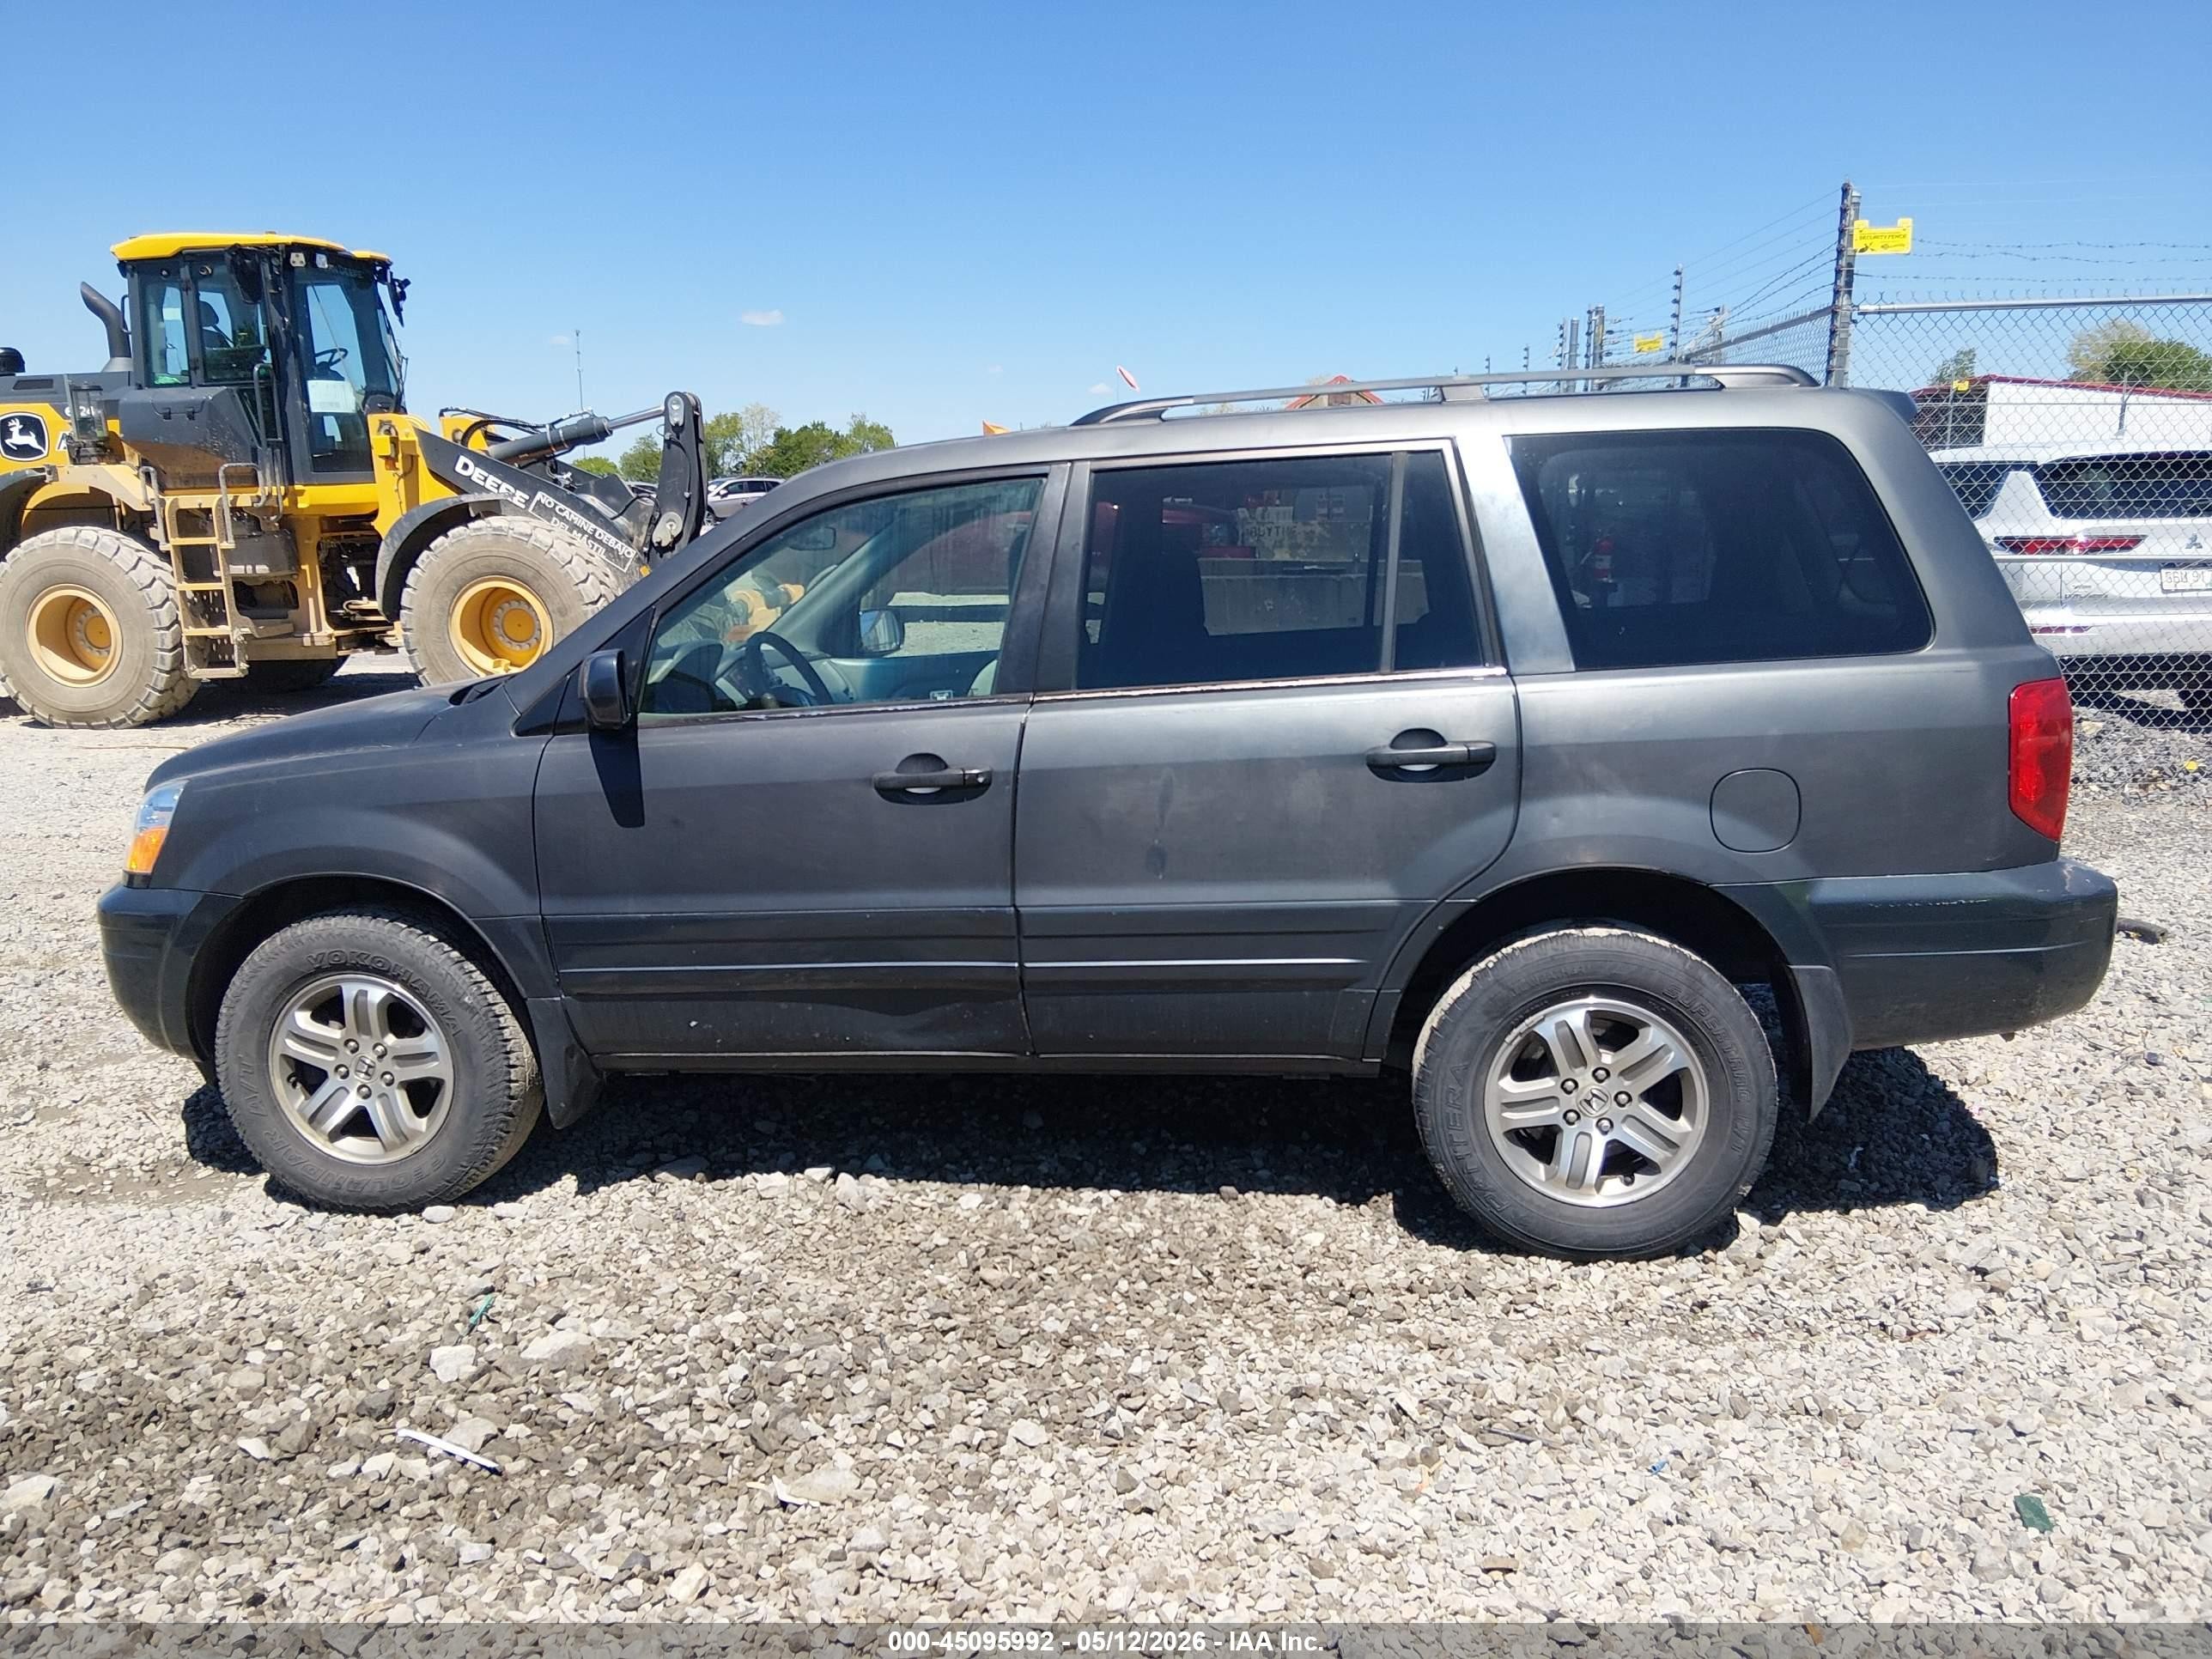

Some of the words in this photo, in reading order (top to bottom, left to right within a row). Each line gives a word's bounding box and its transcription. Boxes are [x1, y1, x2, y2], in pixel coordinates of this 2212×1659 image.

[454, 454, 530, 509] DEERE
[538, 492, 555, 508] NO
[555, 502, 595, 534] CAMINE
[594, 529, 636, 558] DEBAJO
[550, 517, 570, 534] DEL
[307, 949, 462, 1038] YOKOHAMA
[264, 1128, 447, 1194] GEOLANDAR
[1446, 1062, 1511, 1212] PANTERA
